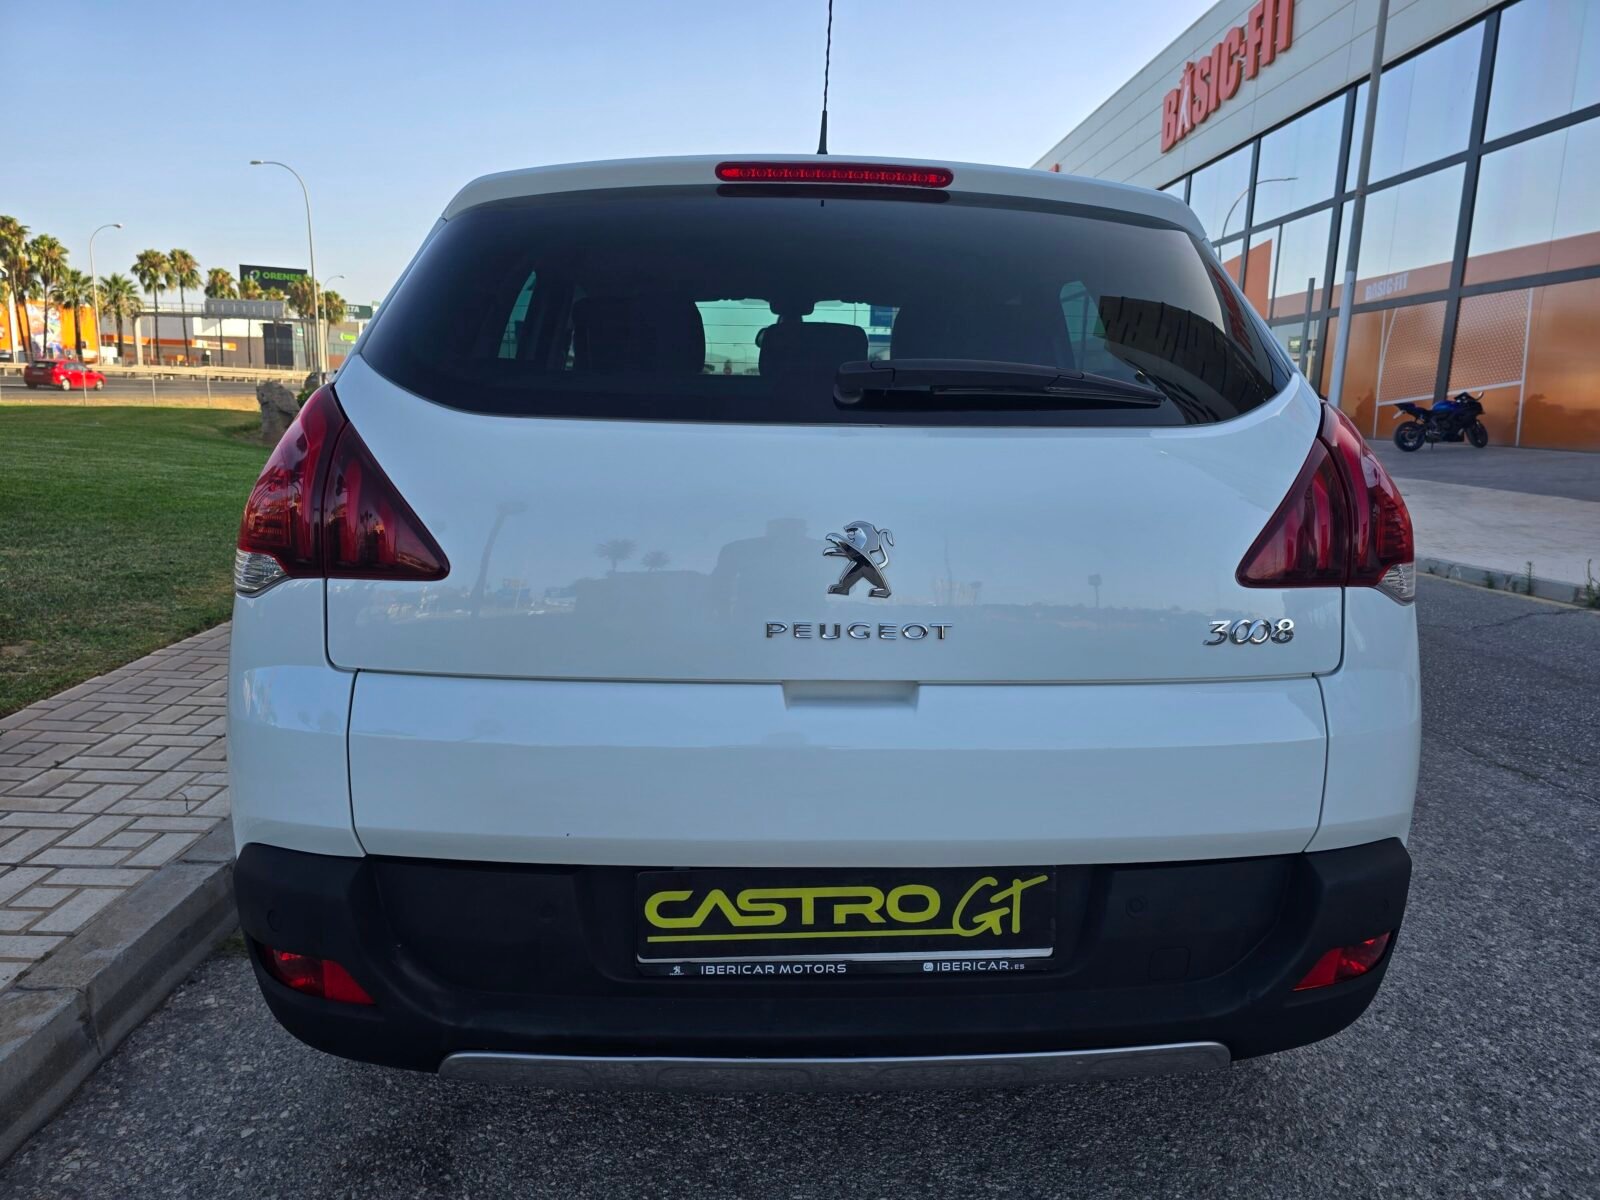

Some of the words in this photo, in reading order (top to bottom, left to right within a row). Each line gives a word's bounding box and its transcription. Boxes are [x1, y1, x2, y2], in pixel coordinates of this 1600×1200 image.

[766, 621, 953, 640] PEUGEOT
[1203, 618, 1295, 646] 3008
[644, 884, 942, 929] CASTRO
[951, 875, 1049, 938] GT
[700, 964, 776, 976] IBERICAR
[779, 963, 848, 975] MOTORS
